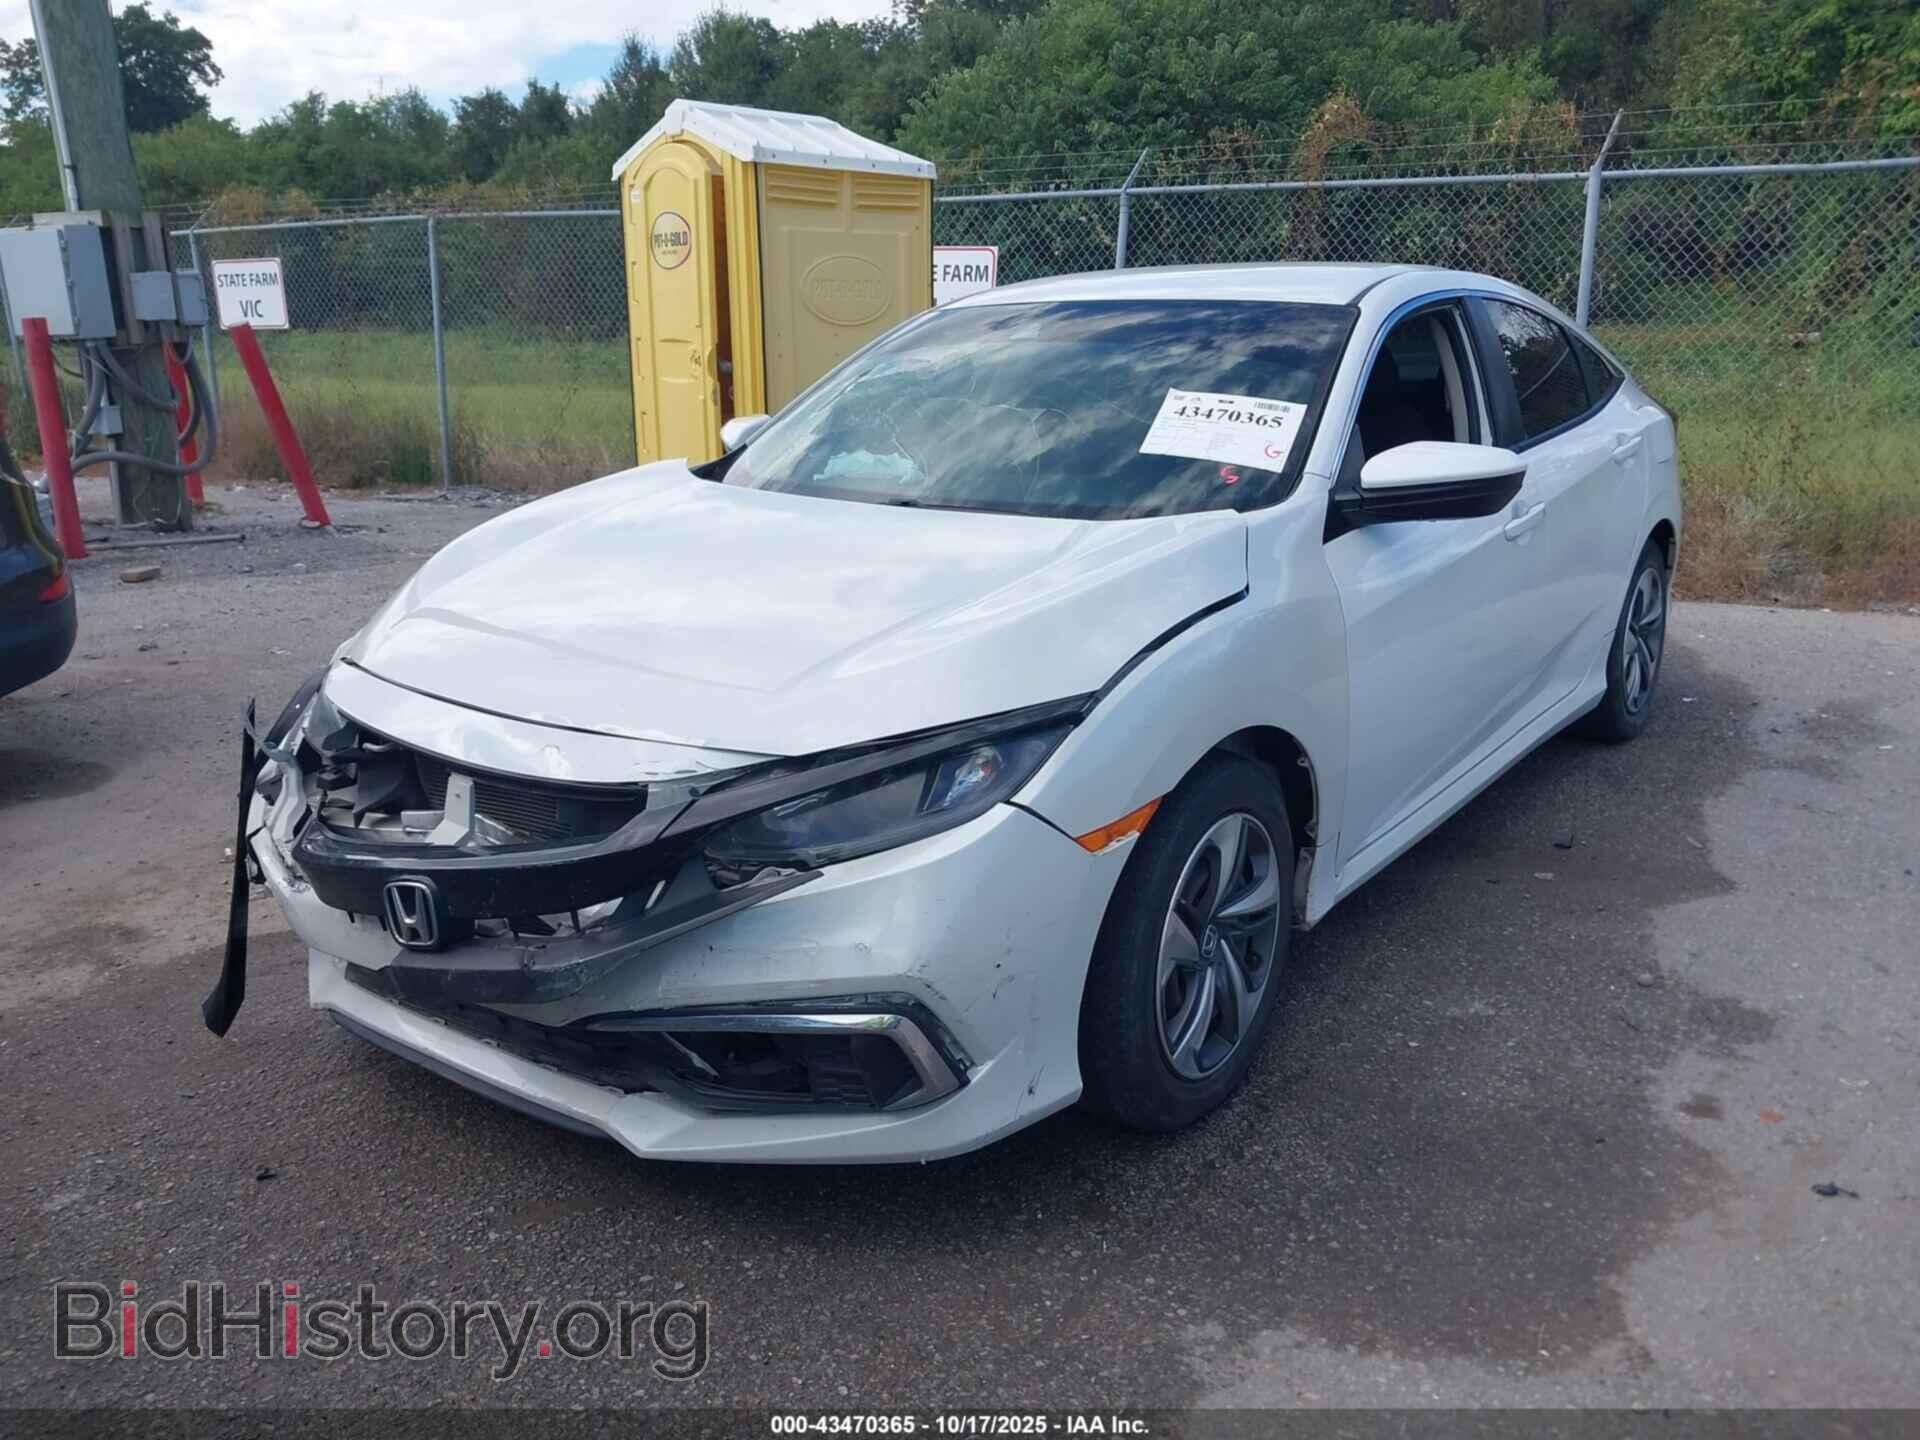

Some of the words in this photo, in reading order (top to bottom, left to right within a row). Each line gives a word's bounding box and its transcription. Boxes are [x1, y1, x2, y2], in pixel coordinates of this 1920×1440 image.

[216, 273, 248, 288] STATE
[249, 272, 279, 287] FARM
[943, 264, 989, 282] FARM
[239, 299, 264, 318] VIC
[1173, 405, 1284, 429] 43470365
